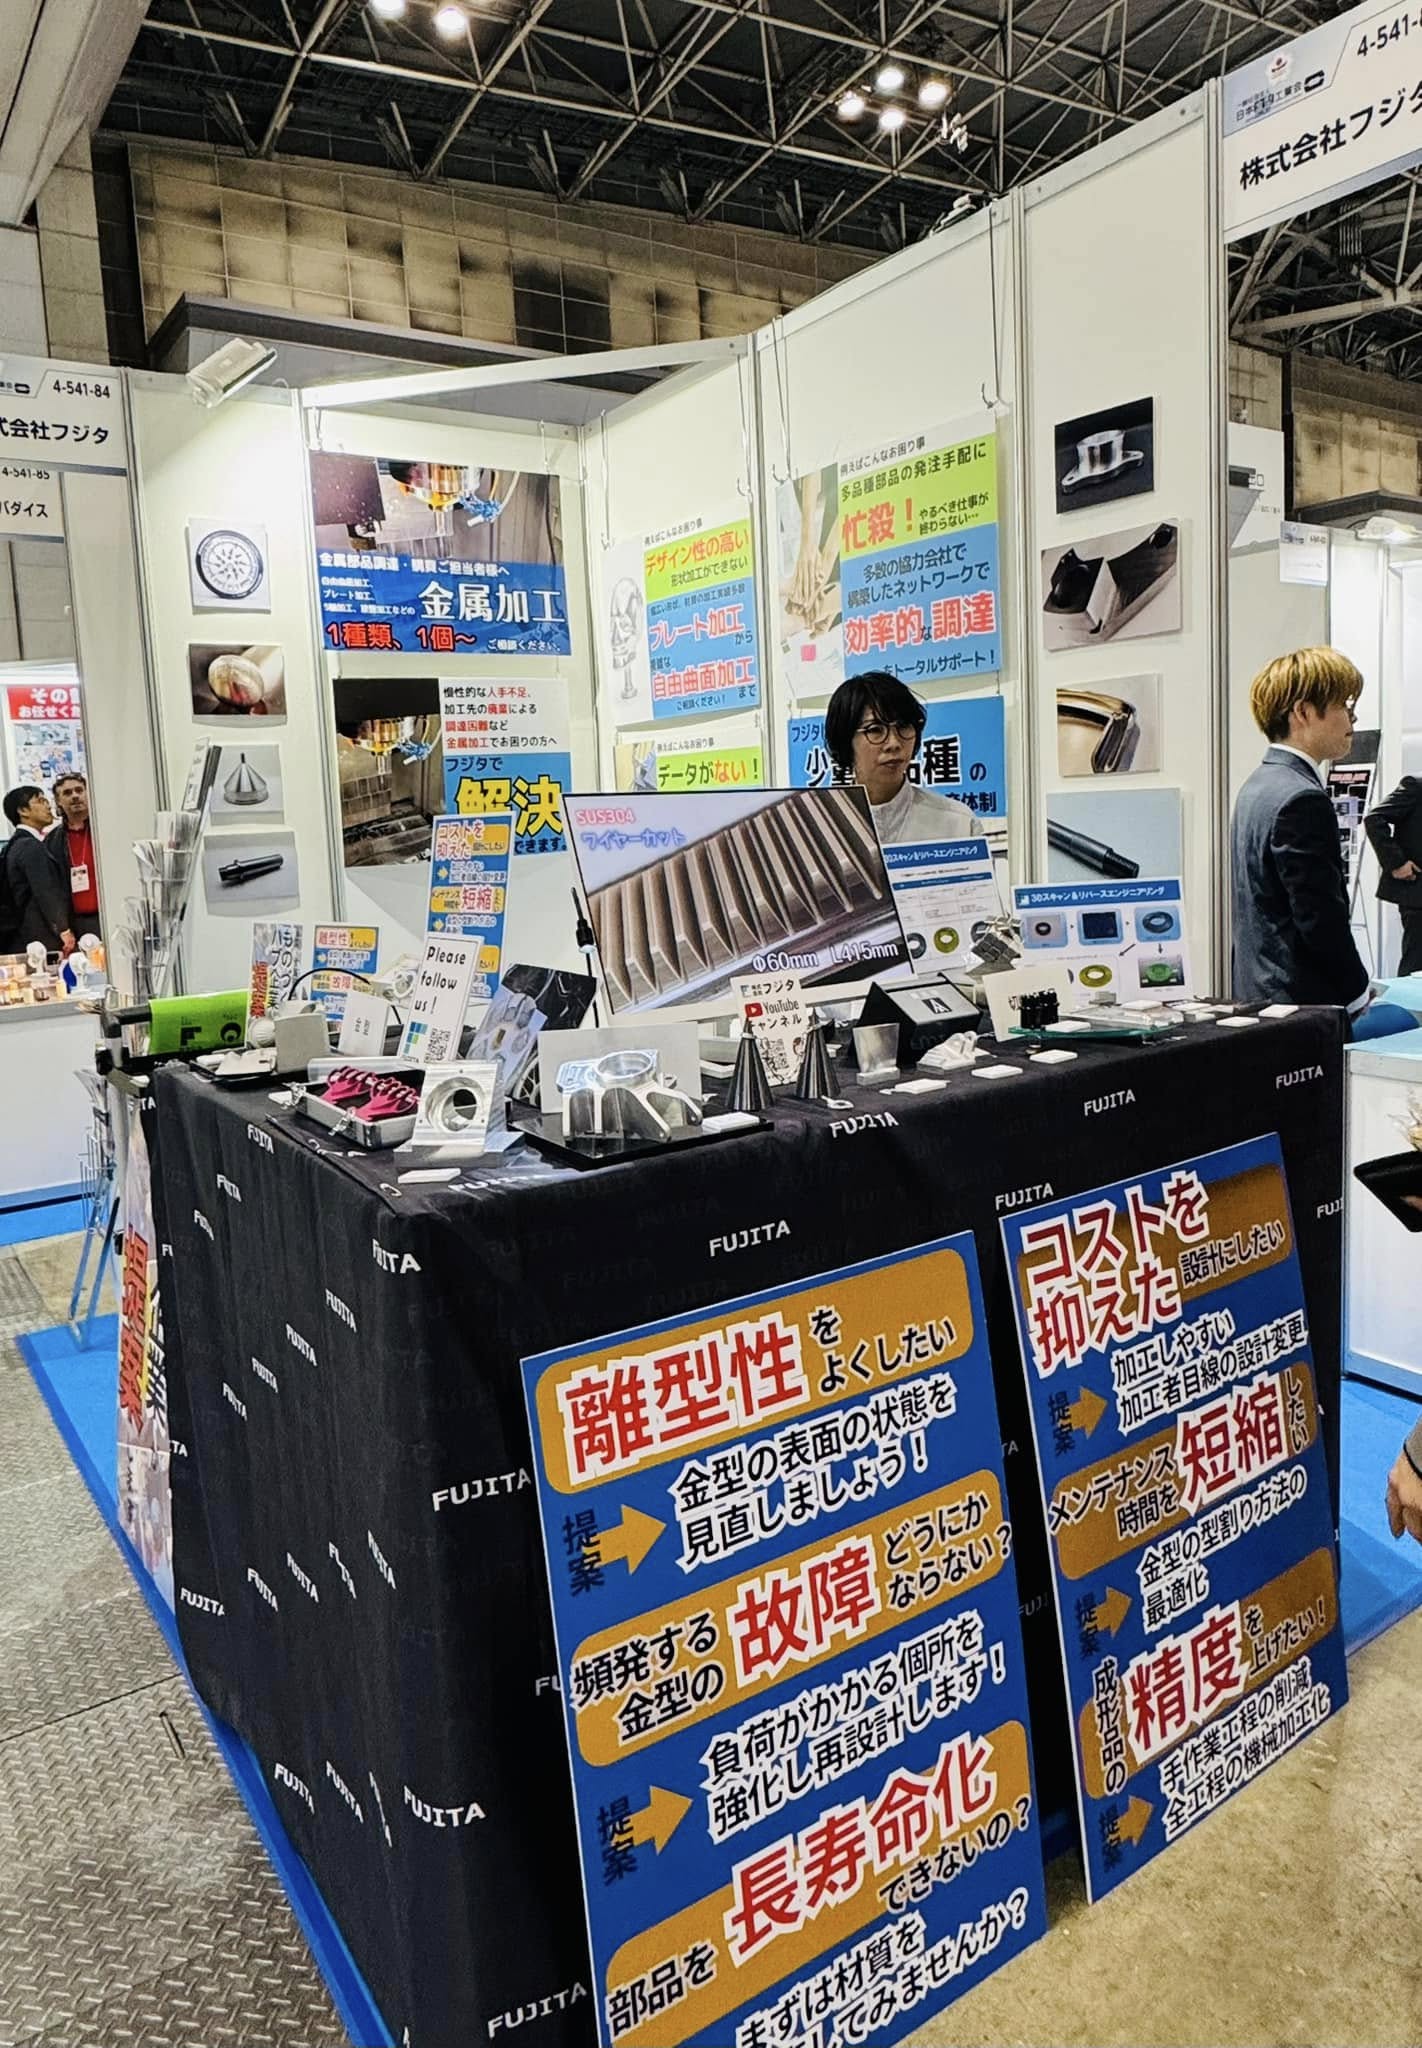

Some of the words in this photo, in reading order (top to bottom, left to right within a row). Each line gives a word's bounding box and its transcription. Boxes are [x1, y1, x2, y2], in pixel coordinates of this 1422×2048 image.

[1357, 8, 1422, 57] 4-541-
[53, 379, 110, 399] 4-541-84
[841, 442, 987, 502] 多品種部品の発注手配に
[842, 497, 914, 553] 忙殺！
[919, 492, 989, 520] やるべき仕事が
[646, 528, 749, 576] デザイン性の高い
[863, 543, 967, 584] 多数の協力会社で
[417, 580, 565, 623] 金属加工
[848, 562, 990, 609] 構築したネットワークで
[650, 605, 743, 649] プレート加工
[735, 633, 753, 646] から
[653, 657, 754, 698] 自由曲面加工
[738, 684, 756, 698] まで
[445, 757, 503, 772] フジタで
[446, 736, 558, 749] 金属加工でお困りの方へ
[658, 757, 758, 788] データがない！
[456, 774, 562, 836] 解決
[576, 808, 635, 825] SUS304
[581, 829, 686, 849] ワイヤーカット
[421, 971, 458, 989] follow
[426, 946, 466, 965] Please
[832, 942, 899, 964] L415mm
[763, 998, 799, 1014] YouTube
[764, 979, 794, 994] フジタ
[1083, 1089, 1137, 1116] FUJITA
[1275, 1065, 1325, 1089] FUJITA
[995, 1182, 1054, 1211] FUJITA
[709, 1220, 791, 1257] FUJITA
[1025, 1177, 1206, 1287] コストを
[1181, 1221, 1285, 1286] 設計にしたい
[326, 1288, 357, 1333] FUJITA
[812, 1308, 841, 1345] を
[1032, 1261, 1179, 1370] 抑えた
[286, 1323, 318, 1367] FUJITA
[820, 1318, 956, 1393] よくしたい
[1114, 1311, 1234, 1387] 加工しやすい
[1121, 1318, 1307, 1428] 加工者目線の設計変更
[563, 1319, 804, 1475] 離型性
[1285, 1369, 1309, 1453] したい
[676, 1378, 955, 1514] 金型の表面の状態を
[1181, 1381, 1284, 1503] 短縮
[432, 1467, 532, 1512] FUJITA
[686, 1437, 927, 1564] 見直しましょう！
[1050, 1445, 1175, 1533] メンテナンス
[1116, 1483, 1178, 1538] 時間を
[562, 1508, 606, 1596] 提案
[886, 1491, 989, 1562] どうにか
[1140, 1467, 1305, 1588] 金型の型割り方法の
[286, 1552, 319, 1602] FUJITA
[890, 1523, 1012, 1609] ならない？
[180, 1587, 225, 1616] FUJITA
[734, 1543, 876, 1678] 故障
[1146, 1569, 1208, 1627] 最適化
[1244, 1608, 1263, 1636] を
[572, 1612, 719, 1705] 頻発する
[1249, 1599, 1325, 1676] 上げたい！
[618, 1660, 724, 1743] 金型の
[707, 1616, 982, 1785] 負荷がかかる個所を
[1130, 1609, 1242, 1750] 精度
[713, 1647, 1005, 1836] 強化し再設計します！
[1094, 1658, 1126, 1793] 成形品の
[1162, 1661, 1312, 1792] 手作業工程の削減
[1168, 1686, 1330, 1834] 全工程の機械加工化
[403, 1785, 487, 1828] FUJITA
[733, 1741, 994, 1956] 長寿命化
[881, 1797, 1031, 1911] できないの？
[487, 1981, 588, 2039] FUJITA
[606, 1946, 716, 2036] 部品を
[741, 1919, 921, 2048] まずは材質を
